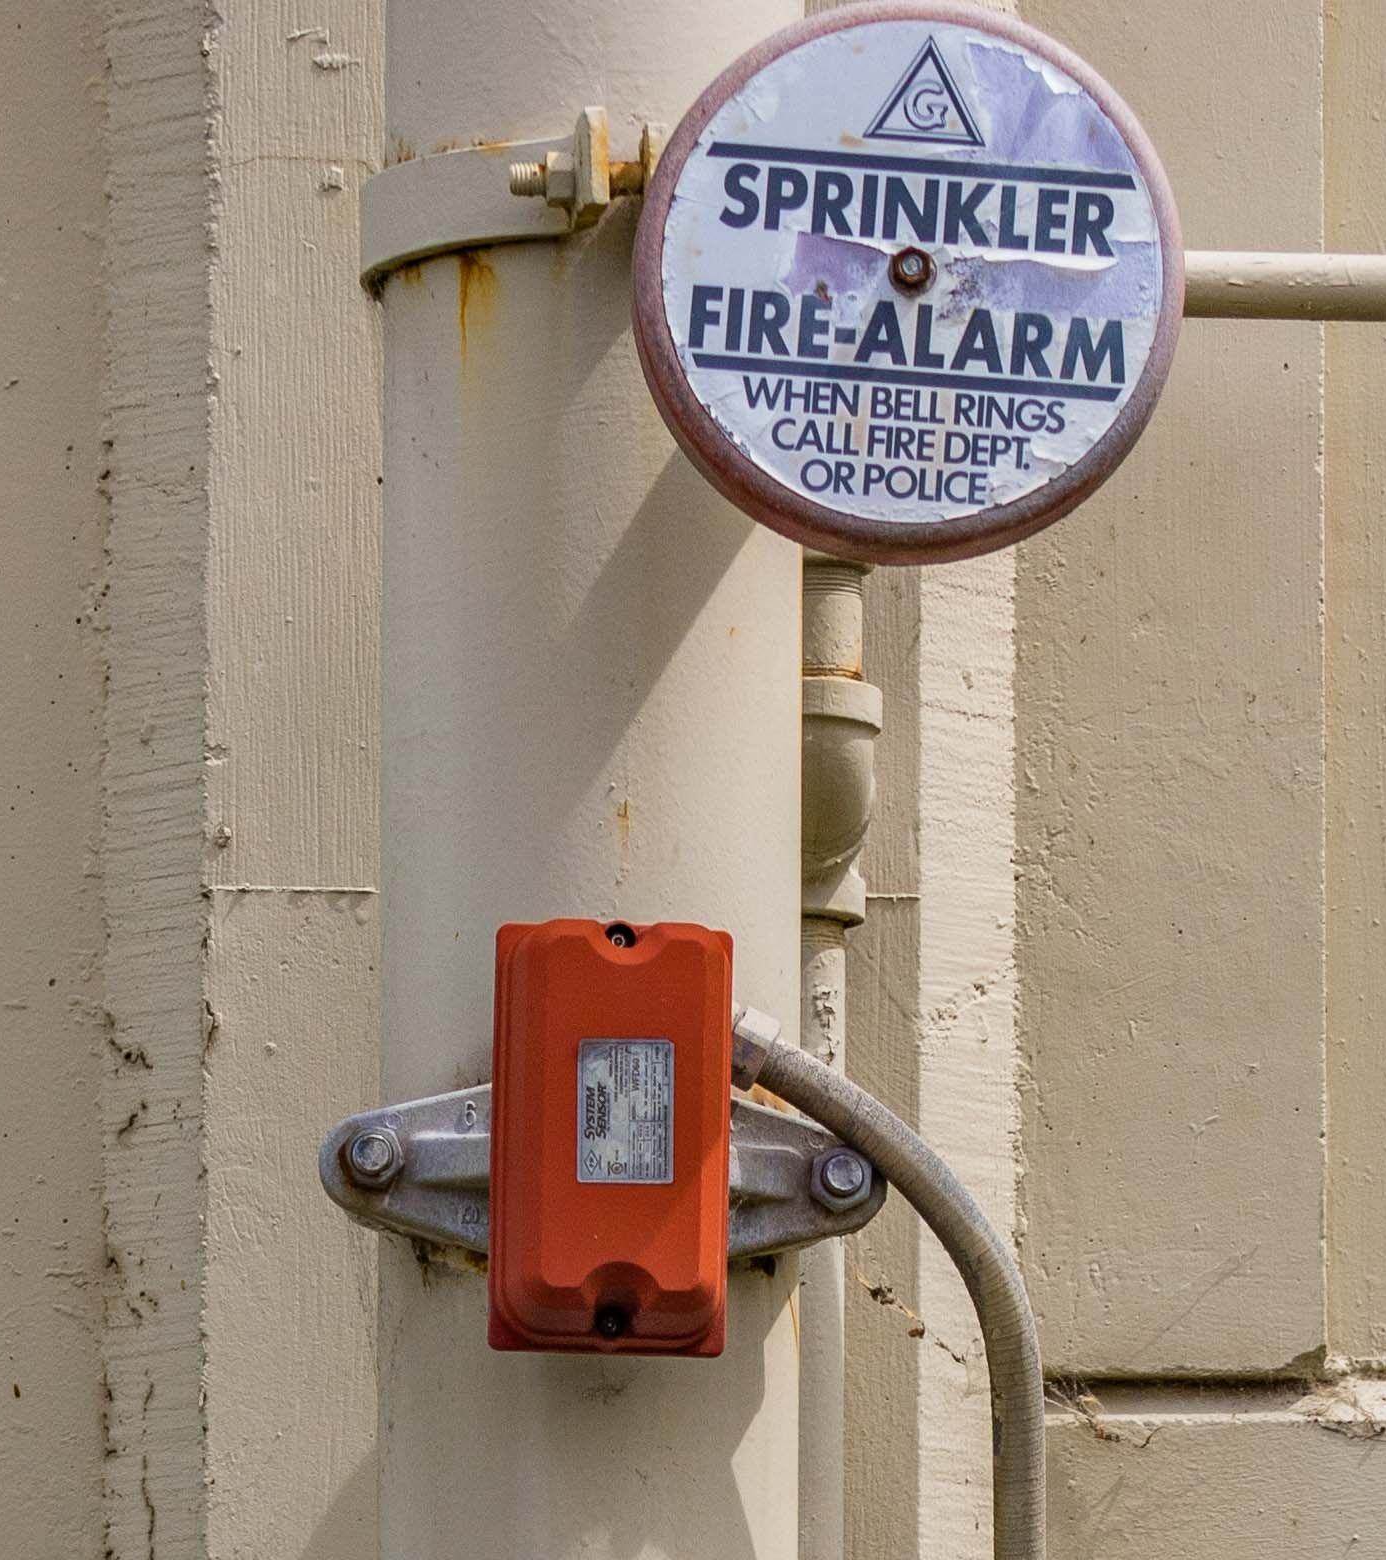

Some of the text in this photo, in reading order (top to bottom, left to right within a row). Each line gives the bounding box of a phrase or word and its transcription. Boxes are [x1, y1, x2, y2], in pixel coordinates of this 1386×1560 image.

[904, 79, 949, 130] G
[719, 162, 1115, 258] SPRINKLER
[688, 284, 1125, 384] FIRE-ALARM
[744, 376, 1065, 434] WHEN BELL RINGS
[771, 418, 1031, 470] CALL FIRE DEPT.
[800, 459, 987, 505] OR POLICE
[584, 1087, 595, 1141] SYSTEM
[596, 1082, 607, 1139] SENSOR
